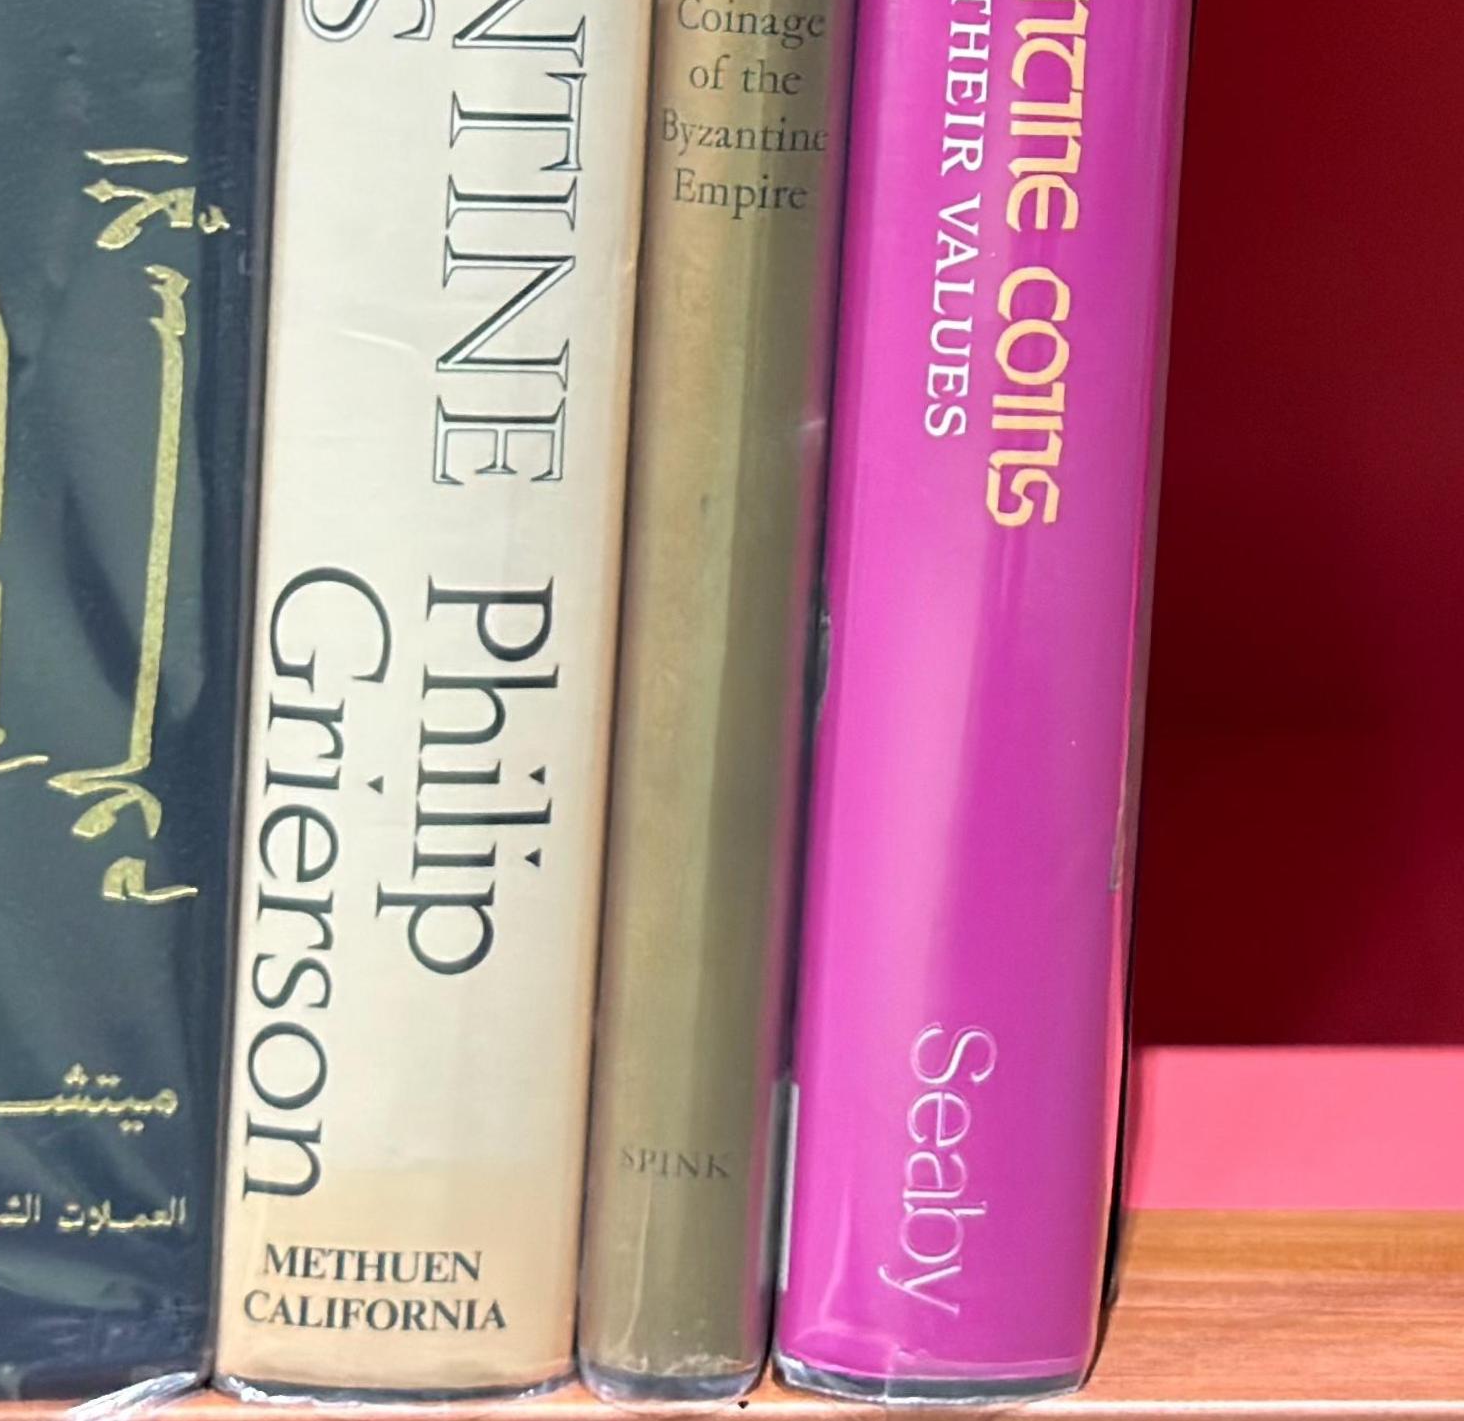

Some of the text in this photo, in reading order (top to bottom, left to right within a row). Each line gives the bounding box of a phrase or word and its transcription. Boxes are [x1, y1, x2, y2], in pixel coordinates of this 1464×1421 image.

[689, 53, 803, 96] of the
[661, 108, 828, 153] Byzantine
[671, 167, 809, 220] Empire
[923, 196, 983, 441] VALUES
[985, 266, 1073, 528] COINS
[374, 575, 560, 975] Philip
[241, 566, 393, 1202] Grierson
[622, 1147, 732, 1179] SPINK
[878, 1021, 998, 1319] Seaby
[262, 1243, 484, 1283] METHUEN
[242, 1289, 508, 1332] CALIFORNIA
